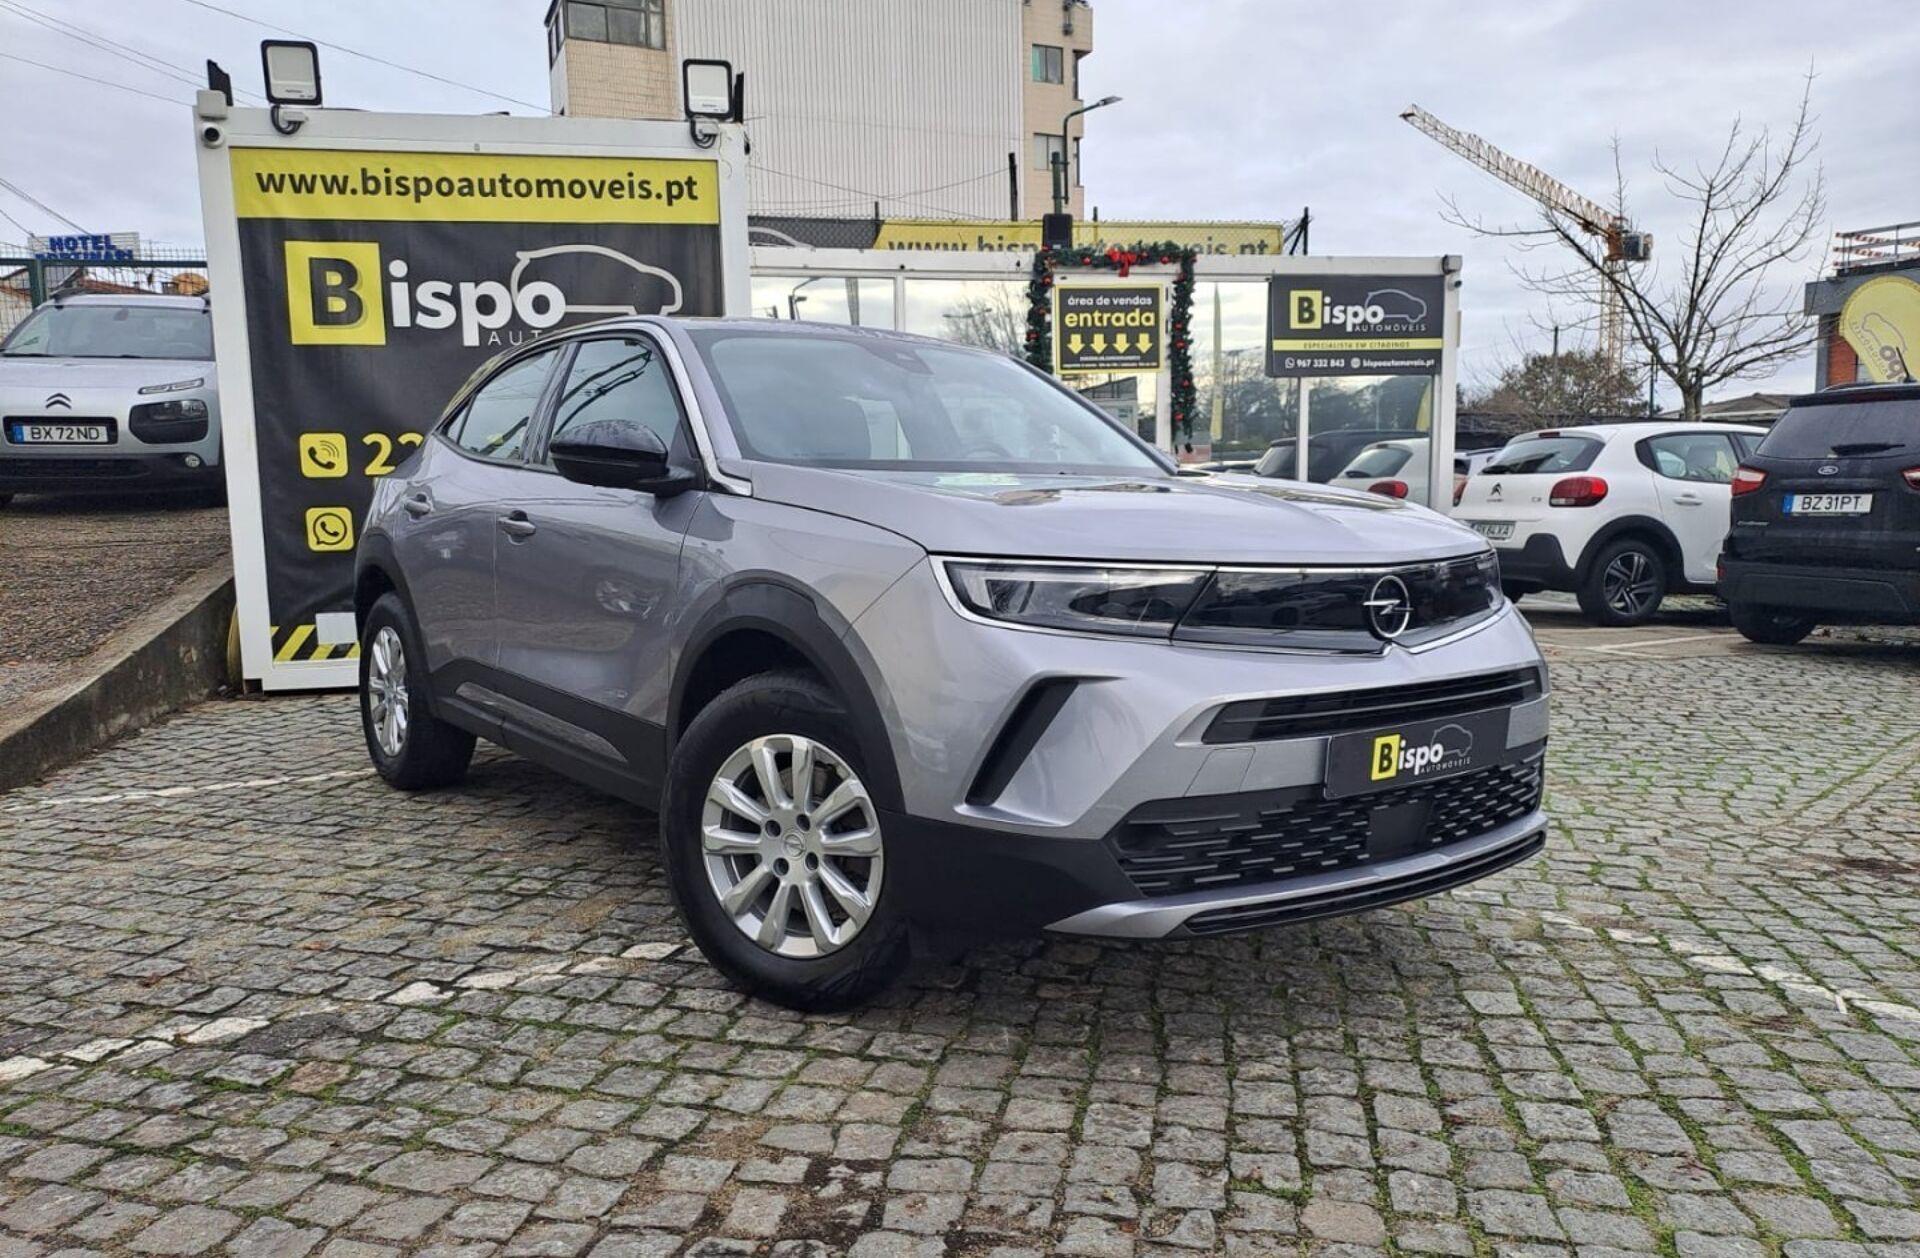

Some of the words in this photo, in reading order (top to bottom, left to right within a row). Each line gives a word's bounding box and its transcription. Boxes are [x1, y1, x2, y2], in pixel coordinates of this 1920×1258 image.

[256, 166, 698, 206] www.bispoautomoveis.pt
[49, 235, 116, 251] HOTEL
[309, 257, 566, 347] Bispo
[1065, 308, 1155, 327] entrada
[1068, 295, 1094, 306] área
[1096, 295, 1110, 305] de
[1112, 294, 1153, 305] vendas
[1298, 296, 1384, 332] Bispo
[1379, 739, 1444, 776] Bispo
